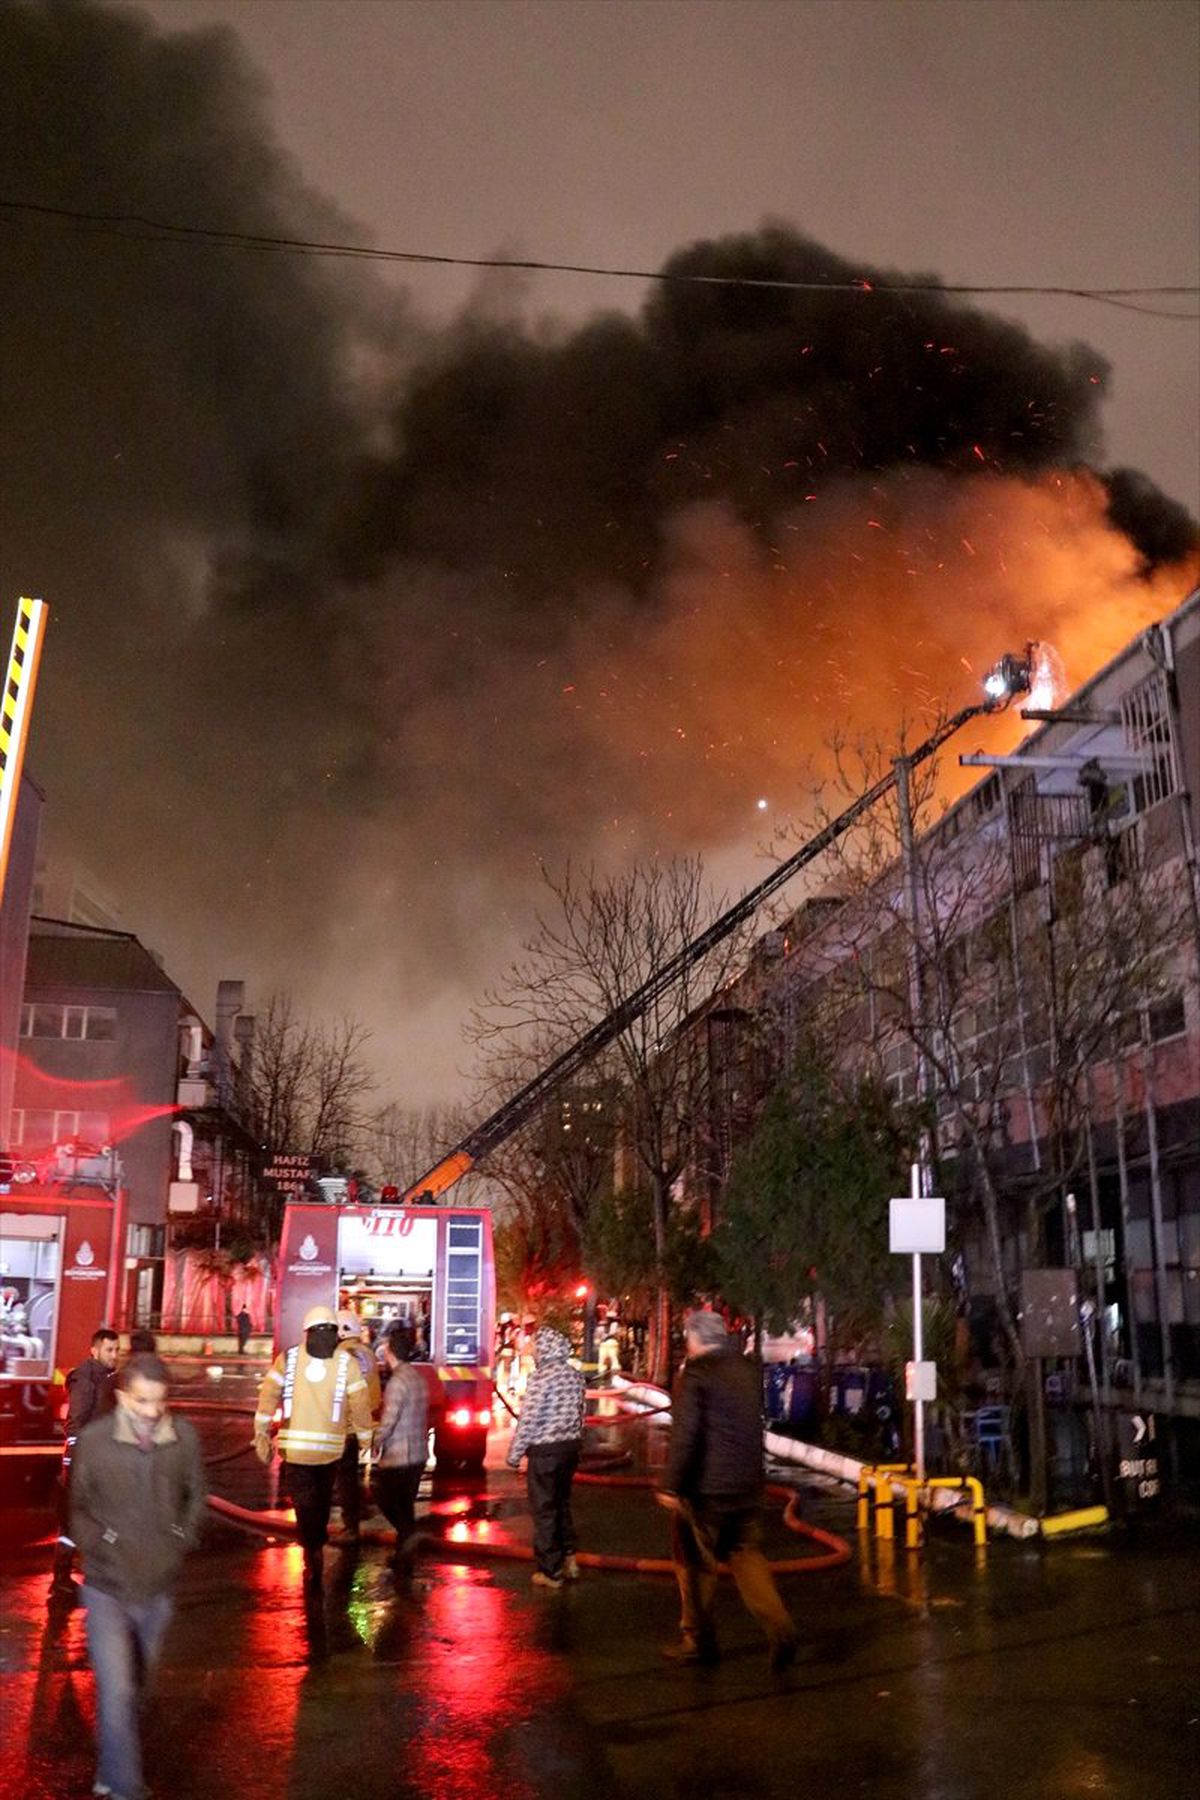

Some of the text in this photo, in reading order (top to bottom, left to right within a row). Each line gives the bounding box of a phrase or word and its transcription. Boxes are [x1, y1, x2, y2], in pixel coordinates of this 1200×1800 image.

[273, 1155, 310, 1166] HAFIZ
[263, 1167, 315, 1179] MUSTAF
[368, 1217, 415, 1236] 110
